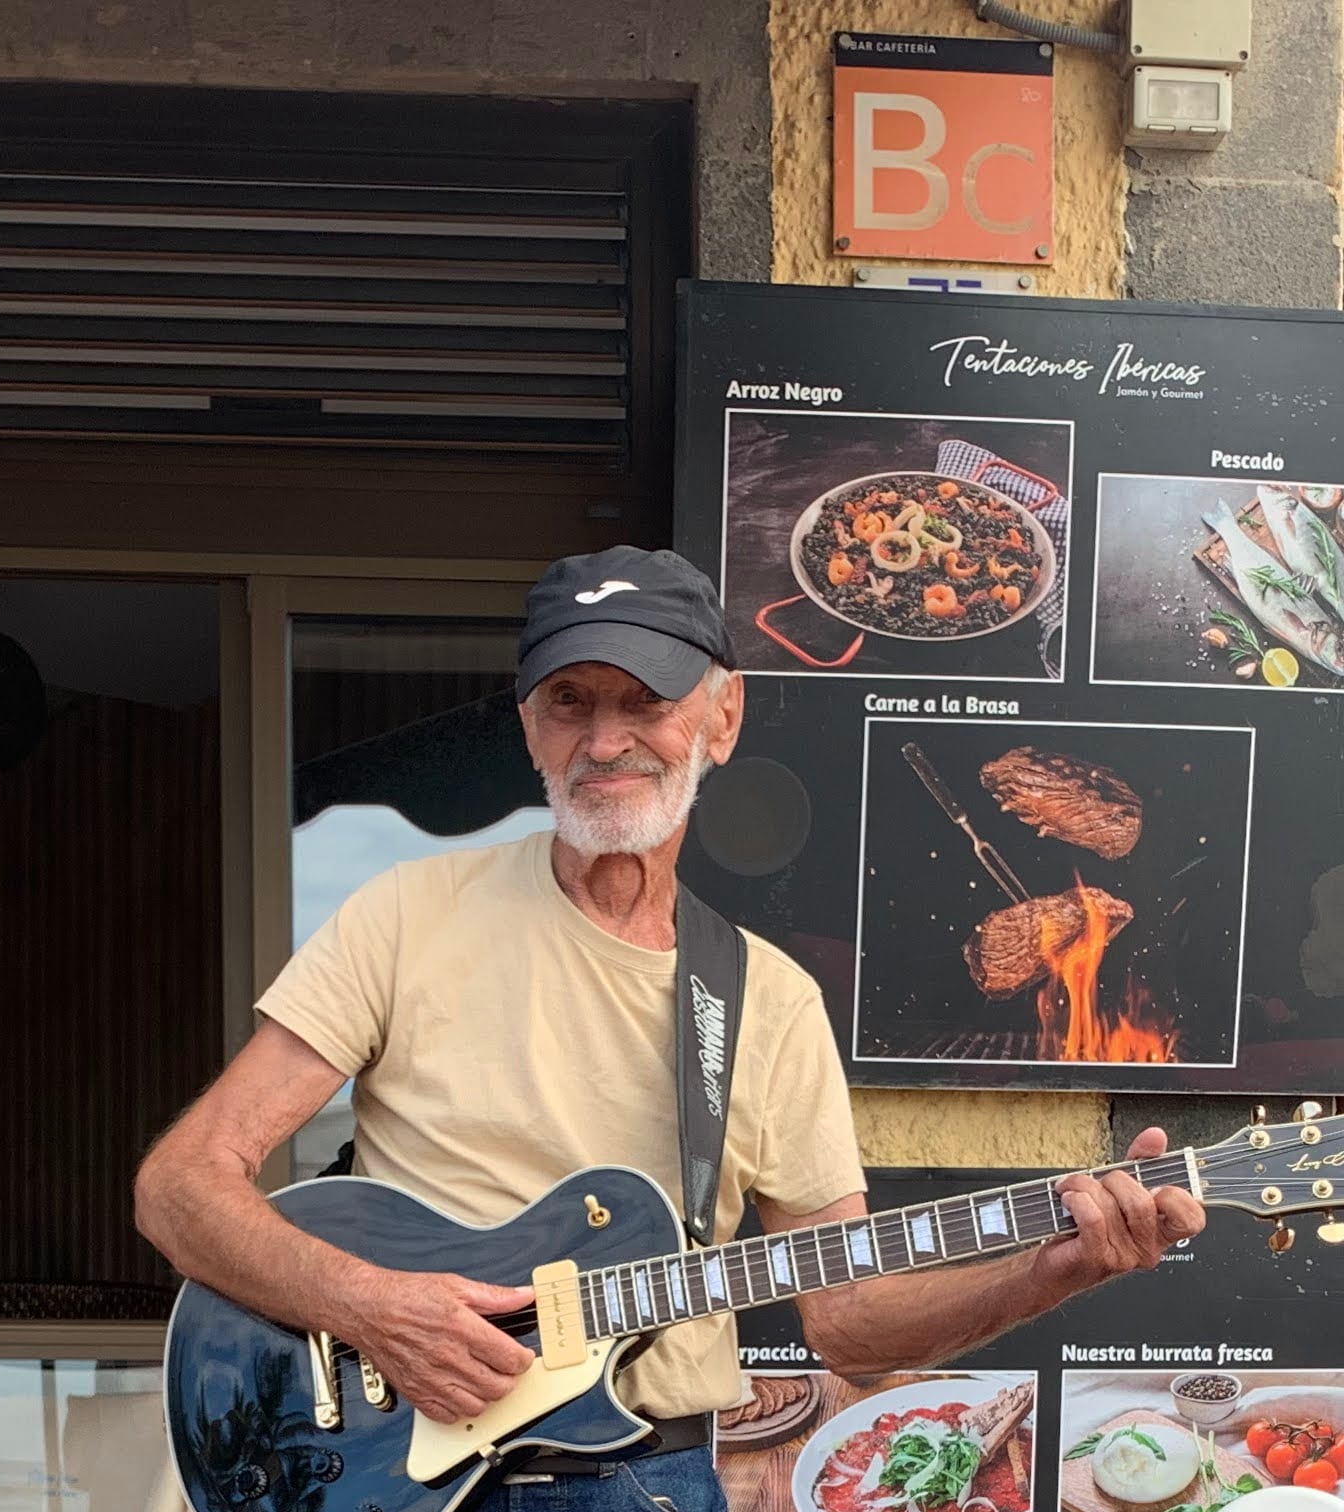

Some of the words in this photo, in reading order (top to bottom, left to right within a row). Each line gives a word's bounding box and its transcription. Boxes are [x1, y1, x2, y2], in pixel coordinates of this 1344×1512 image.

[929, 335, 1094, 387] Tentaciones
[1098, 342, 1207, 395] Ibéricas
[726, 380, 780, 399] Arroz
[784, 381, 843, 406] Negro
[1116, 385, 1149, 397] Jamón
[1151, 389, 1158, 399] y
[1160, 387, 1204, 399] Gourmet
[1211, 449, 1285, 471] Pescado
[864, 693, 919, 713] Carne
[923, 699, 937, 713] a
[941, 694, 960, 714] la
[965, 696, 1020, 715] Brasa
[1159, 1252, 1194, 1262] ourmet
[738, 1342, 808, 1365] rpaccio
[1061, 1344, 1136, 1362] Nuestra
[1141, 1343, 1213, 1362] burrata
[1217, 1343, 1274, 1366] fresca
